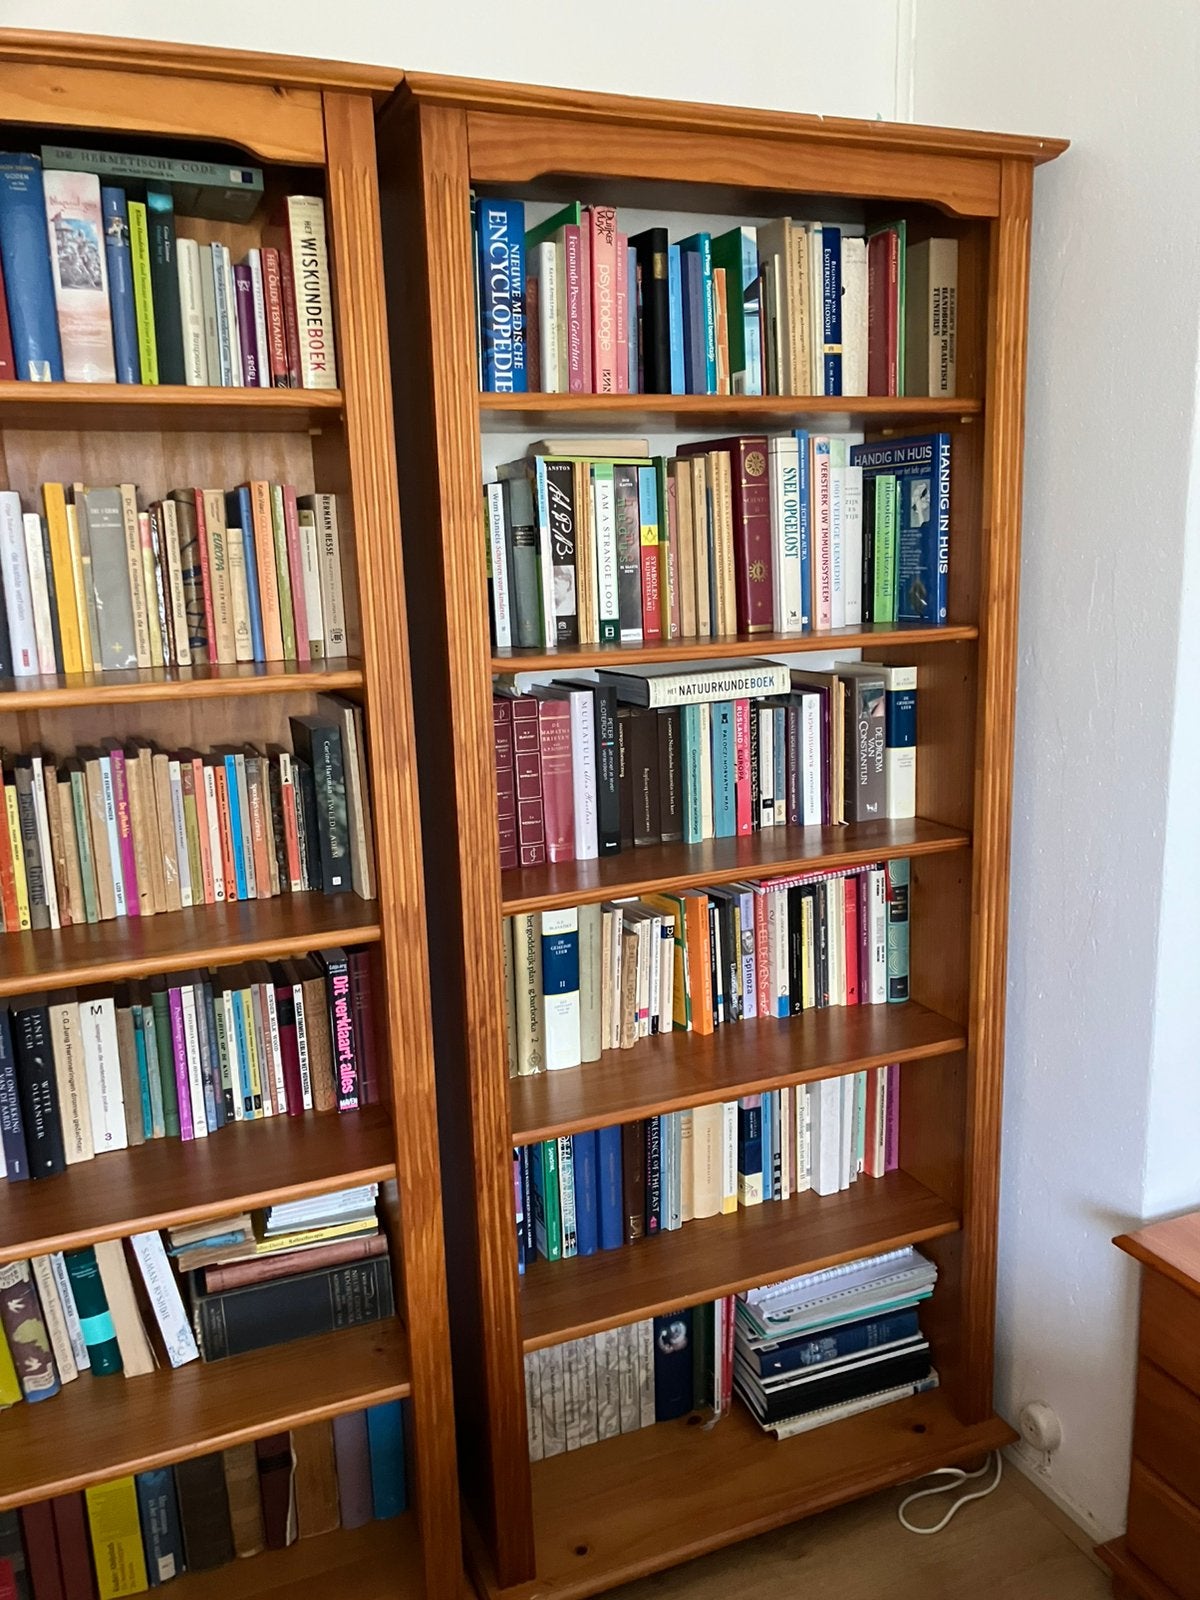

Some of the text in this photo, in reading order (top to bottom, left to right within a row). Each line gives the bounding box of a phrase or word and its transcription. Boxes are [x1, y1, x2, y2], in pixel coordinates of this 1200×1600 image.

[703, 254, 711, 276] Praag
[266, 254, 276, 272] HET
[271, 304, 284, 342] TESTAMENT
[301, 221, 327, 372] HET WISKUNDEBOEK
[488, 210, 514, 393] ENCYCLOPEDIE
[510, 244, 523, 369] NIEUWE MEDISCHE
[568, 235, 581, 371] Fernando Pessoa Gedichten
[597, 264, 612, 351] psychologie
[705, 279, 713, 324] Paranormaal
[932, 287, 941, 336] TUINIEREN
[940, 287, 948, 391] HANDBOEK PRAKTISCH
[246, 354, 256, 382] Tapas
[854, 445, 932, 467] HANDIG IN HUIS
[492, 492, 500, 512] Wim
[602, 493, 610, 510] AM
[783, 467, 798, 559] SNEL OPGELOST
[882, 482, 893, 529] filosofen
[939, 445, 950, 574] HANDIG IN HUIS
[322, 495, 334, 556] HERMANN HESSE
[820, 461, 829, 603] VERSTERK UW IMMUUNSYSTEEM
[883, 531, 891, 549] van
[212, 532, 225, 571] EUROPA
[603, 526, 612, 580] STRANGE
[833, 542, 841, 593] REMEDIES
[883, 551, 892, 572] deze
[645, 555, 653, 612] VRIJMETSELARIJ
[650, 555, 658, 600] SYMBOLEN
[605, 584, 613, 617] LOOP
[679, 675, 775, 696] NATUURKUNDEBOEK
[581, 701, 590, 766] MULTATULI
[600, 700, 608, 739] SLOTERDIJK
[737, 749, 745, 781] EUROPA
[858, 720, 868, 785] CONSTANTIJN
[867, 738, 875, 757] VAN
[874, 726, 883, 773] DE DROOM
[323, 740, 332, 764] Corine
[330, 835, 339, 859] ADEM
[19, 792, 37, 841] Erasmus
[29, 865, 46, 906] Grotius
[524, 928, 535, 966] goddelijk
[526, 966, 536, 984] plan
[744, 957, 754, 995] Spinoza
[24, 1016, 33, 1049] FITCH
[34, 1014, 44, 1046] JANET
[90, 1005, 103, 1016] M
[62, 1025, 73, 1044] Jung
[333, 975, 356, 1093] Dit verklaart alles
[64, 1043, 76, 1092] Herinneringen
[31, 1083, 45, 1139] OLEANDER
[41, 1080, 51, 1113] WITTE
[71, 1092, 79, 1118] dromen
[105, 1132, 112, 1141] 3
[651, 1116, 659, 1159] PRESENCE
[651, 1160, 659, 1171] OF
[652, 1190, 660, 1212] PAST
